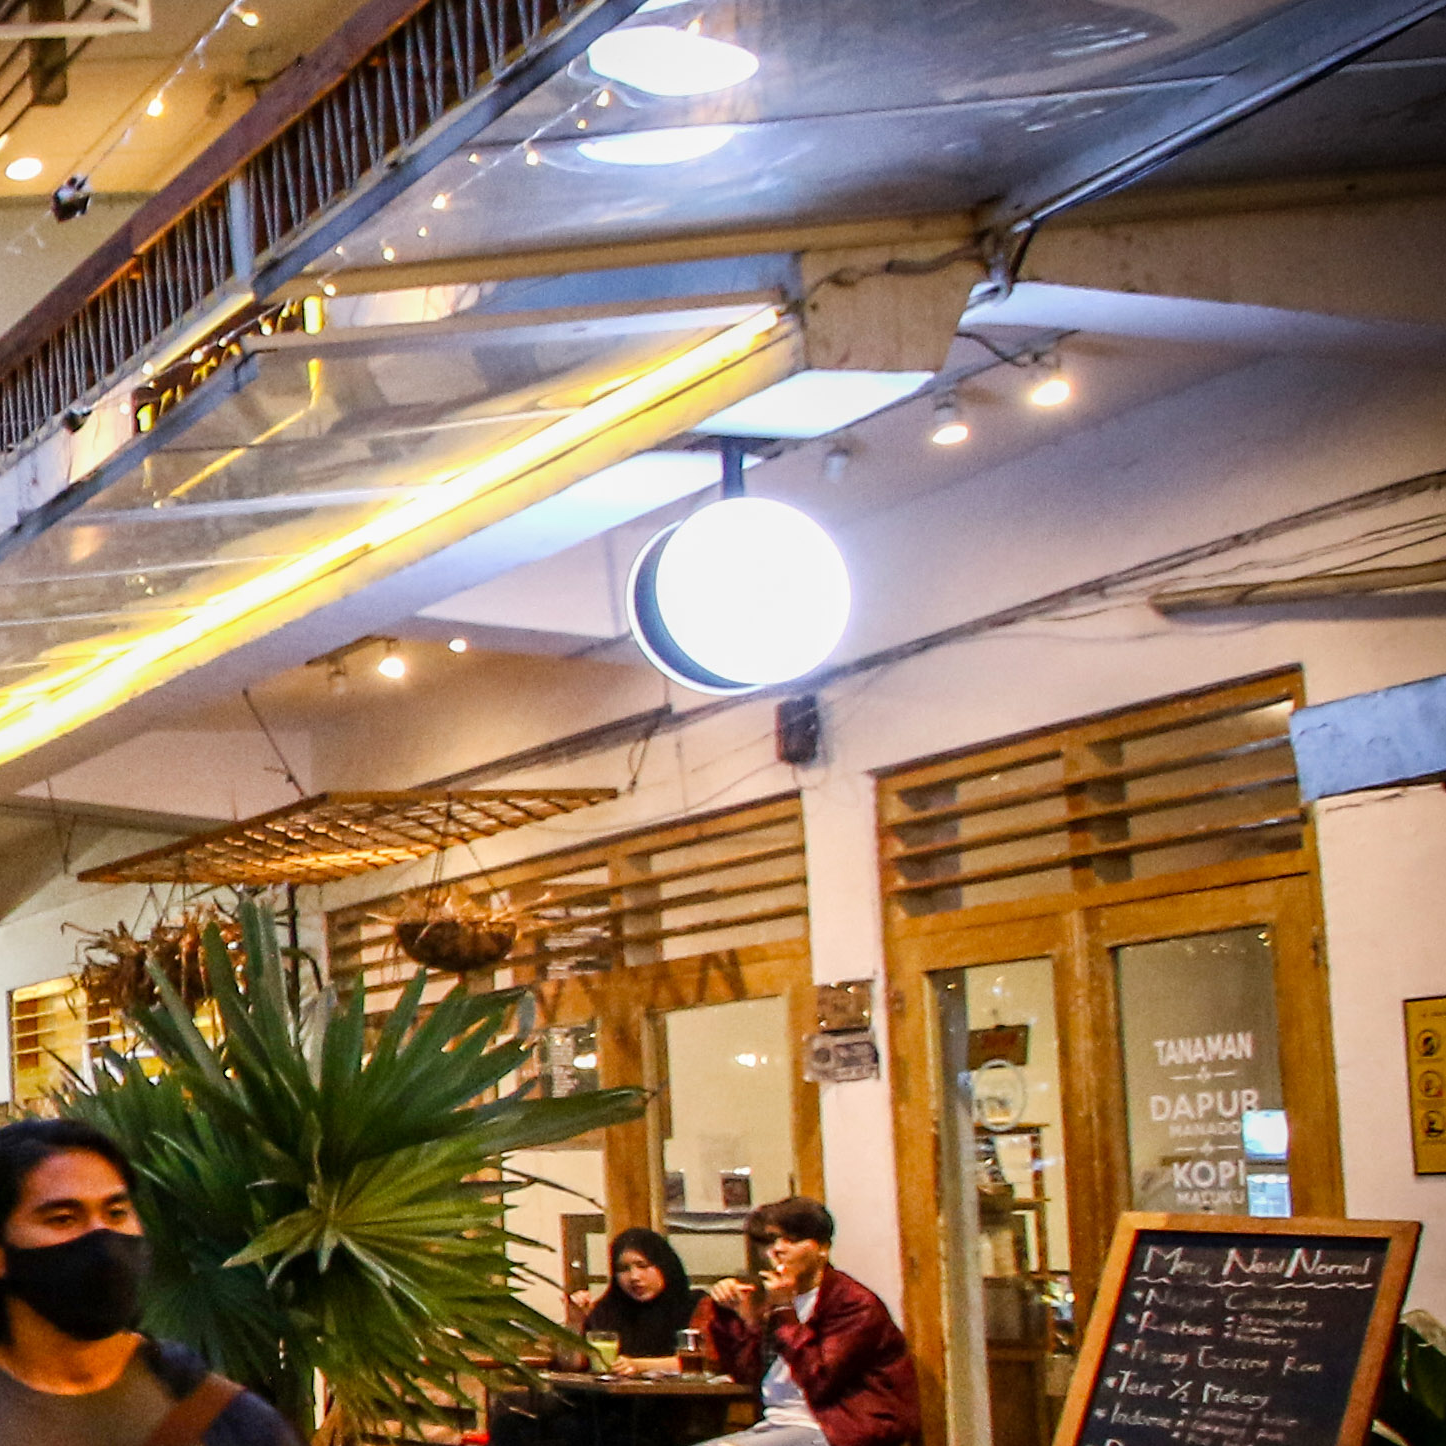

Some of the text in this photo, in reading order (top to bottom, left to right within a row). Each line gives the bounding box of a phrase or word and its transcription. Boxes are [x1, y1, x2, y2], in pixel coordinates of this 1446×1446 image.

[1154, 1032, 1253, 1066] TANAMAN
[1150, 1089, 1259, 1121] DAPUR
[1169, 1121, 1242, 1137] MANADO
[1173, 1159, 1247, 1188] KOPI
[1222, 1247, 1285, 1277] New
[1284, 1247, 1372, 1279] Normal
